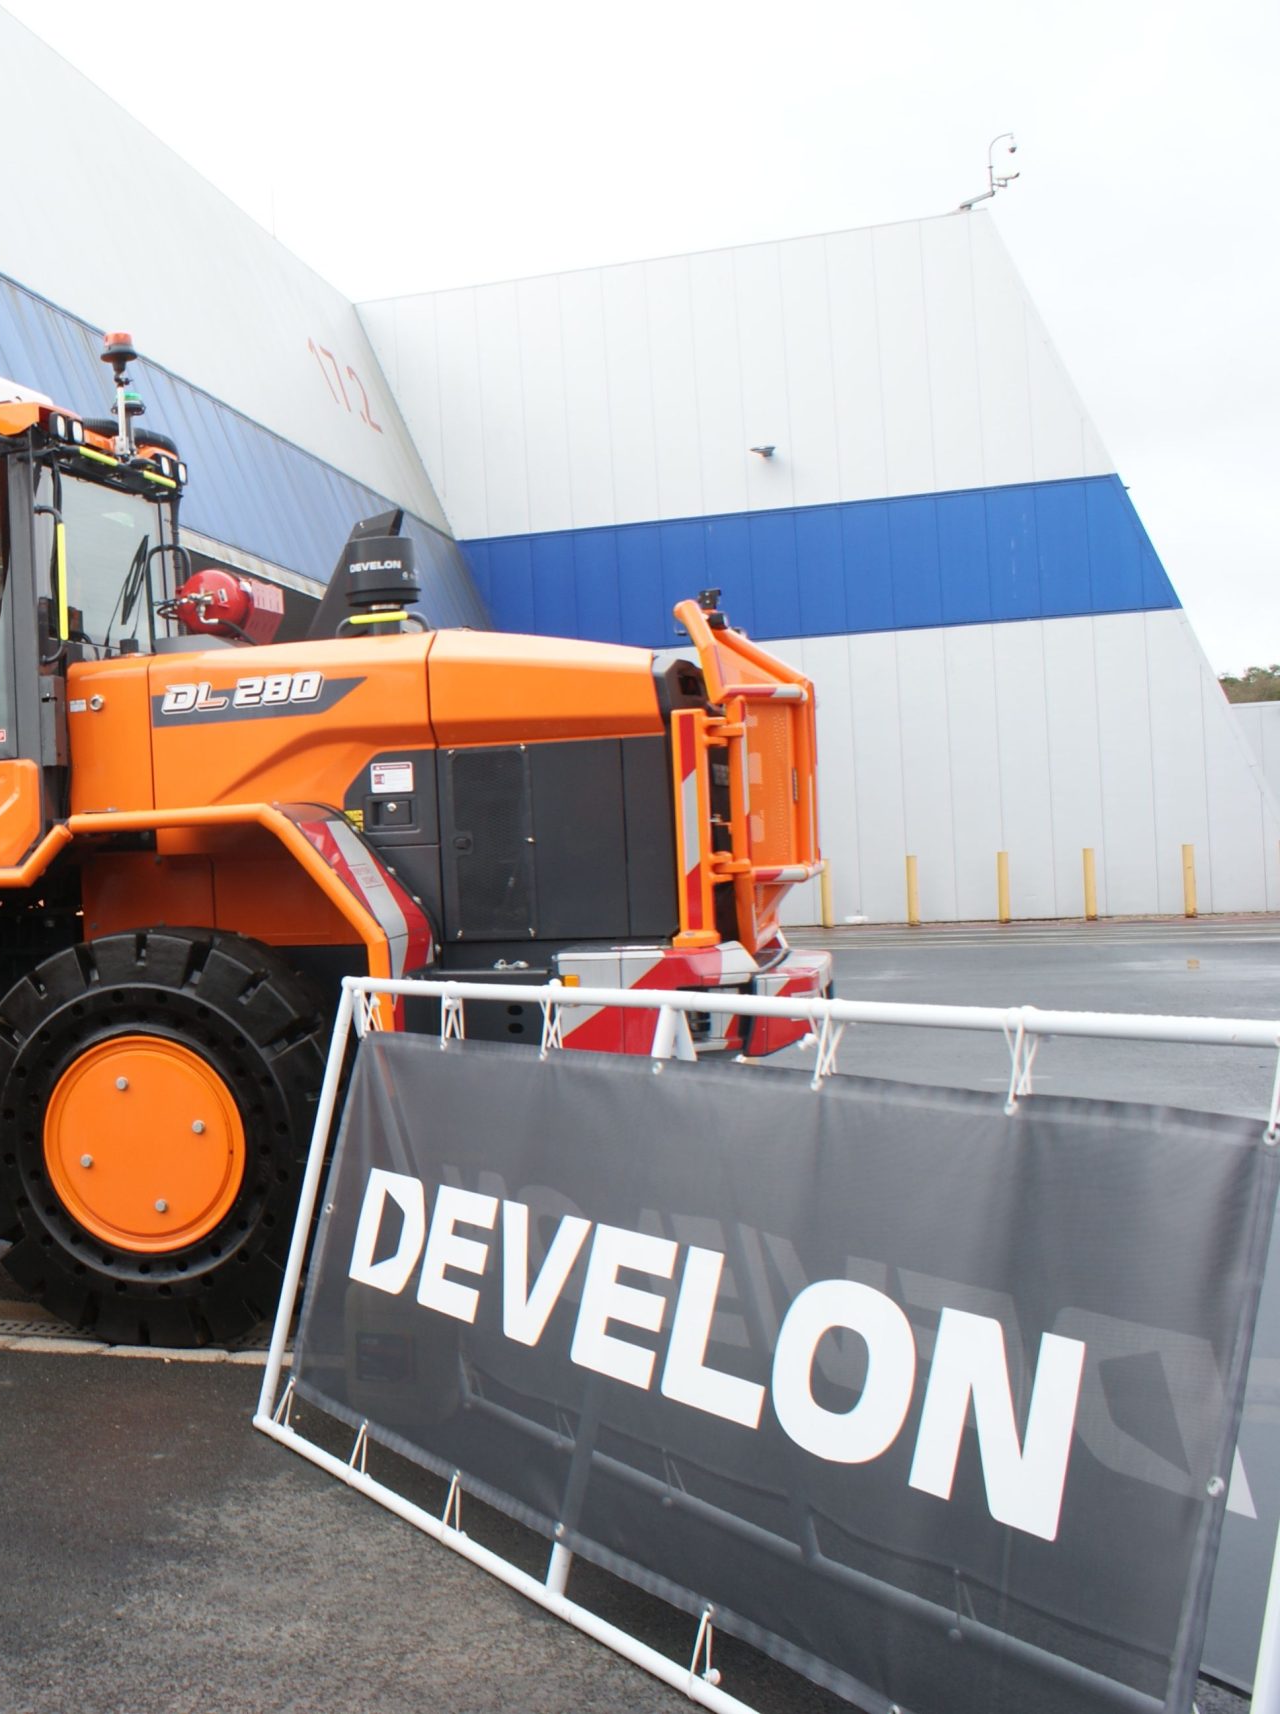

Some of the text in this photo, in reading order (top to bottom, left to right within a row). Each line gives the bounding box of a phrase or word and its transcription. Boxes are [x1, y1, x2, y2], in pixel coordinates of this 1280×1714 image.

[306, 337, 383, 434] 172
[349, 560, 402, 573] DEVELON
[161, 671, 324, 714] DL 280
[348, 1167, 1086, 1542] DEVELON
